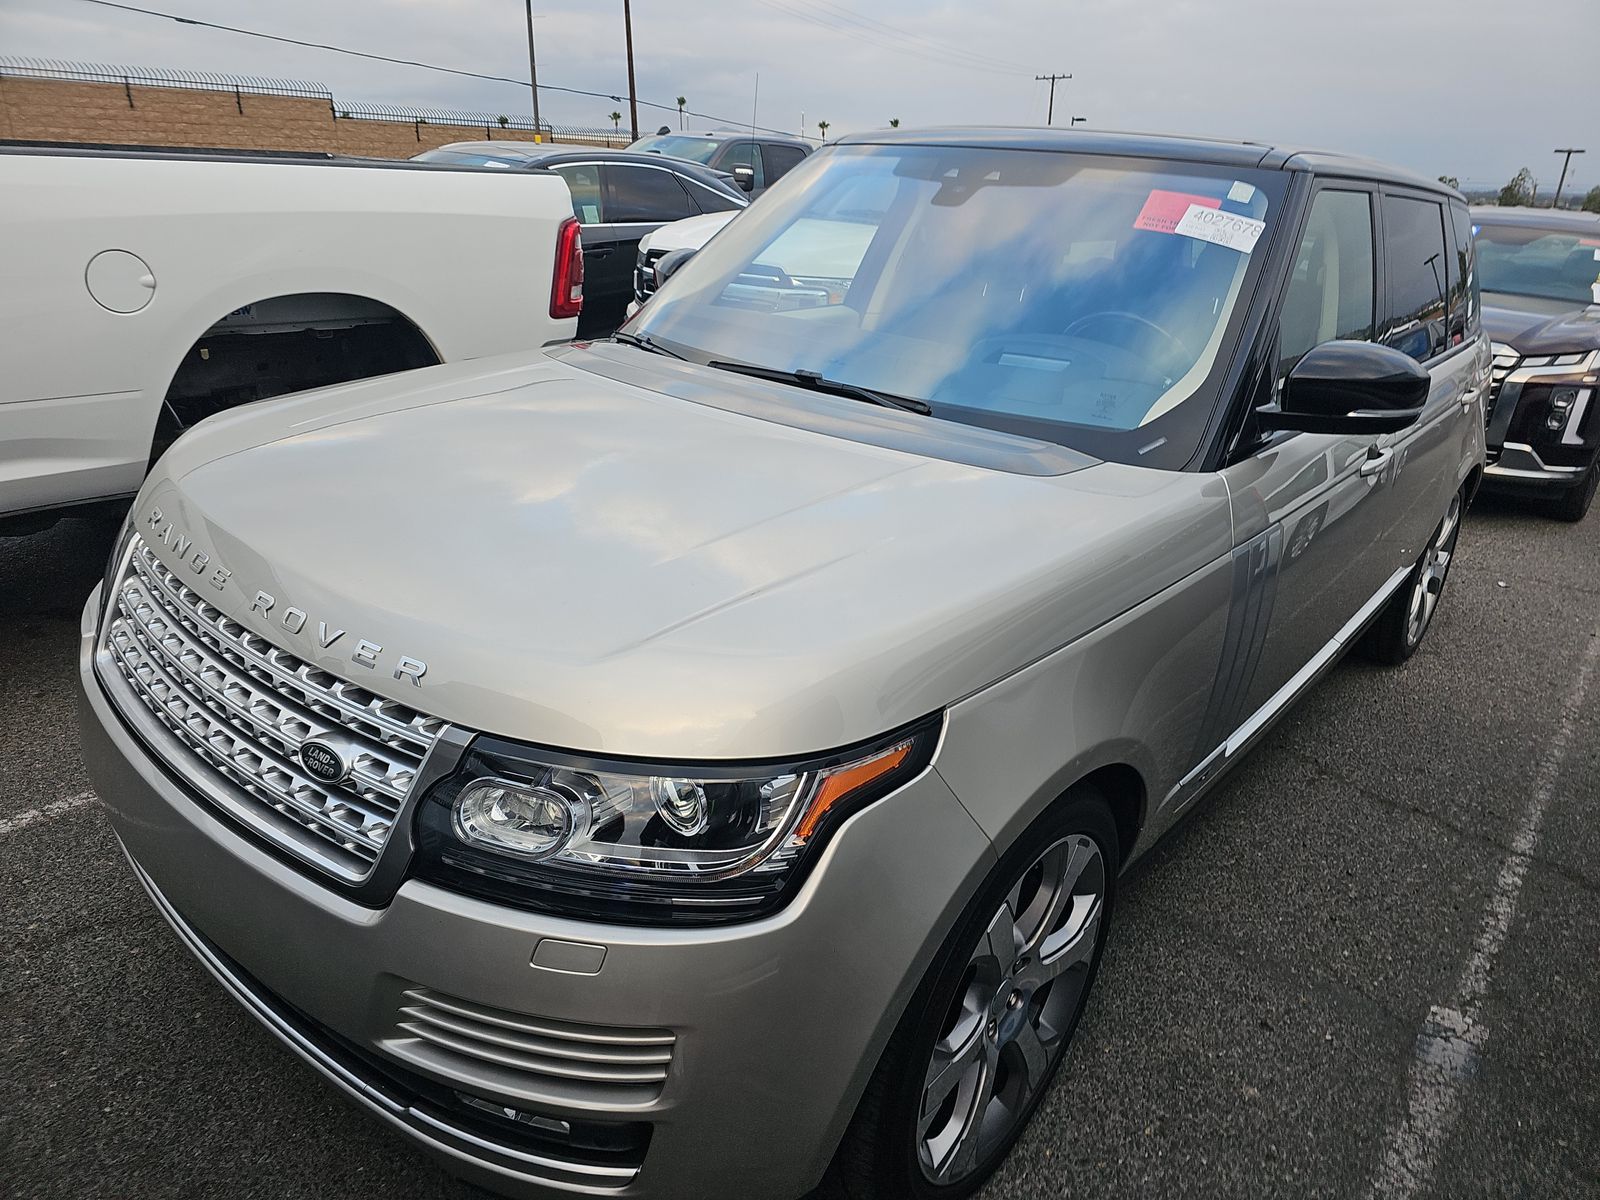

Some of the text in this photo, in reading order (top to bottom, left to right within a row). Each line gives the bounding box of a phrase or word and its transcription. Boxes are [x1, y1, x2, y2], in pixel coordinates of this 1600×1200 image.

[1143, 221, 1158, 229] NOT
[1194, 210, 1262, 238] 4027678
[147, 506, 428, 688] RANGE ROVER
[308, 746, 331, 764] LAND
[306, 757, 335, 777] ROVER
